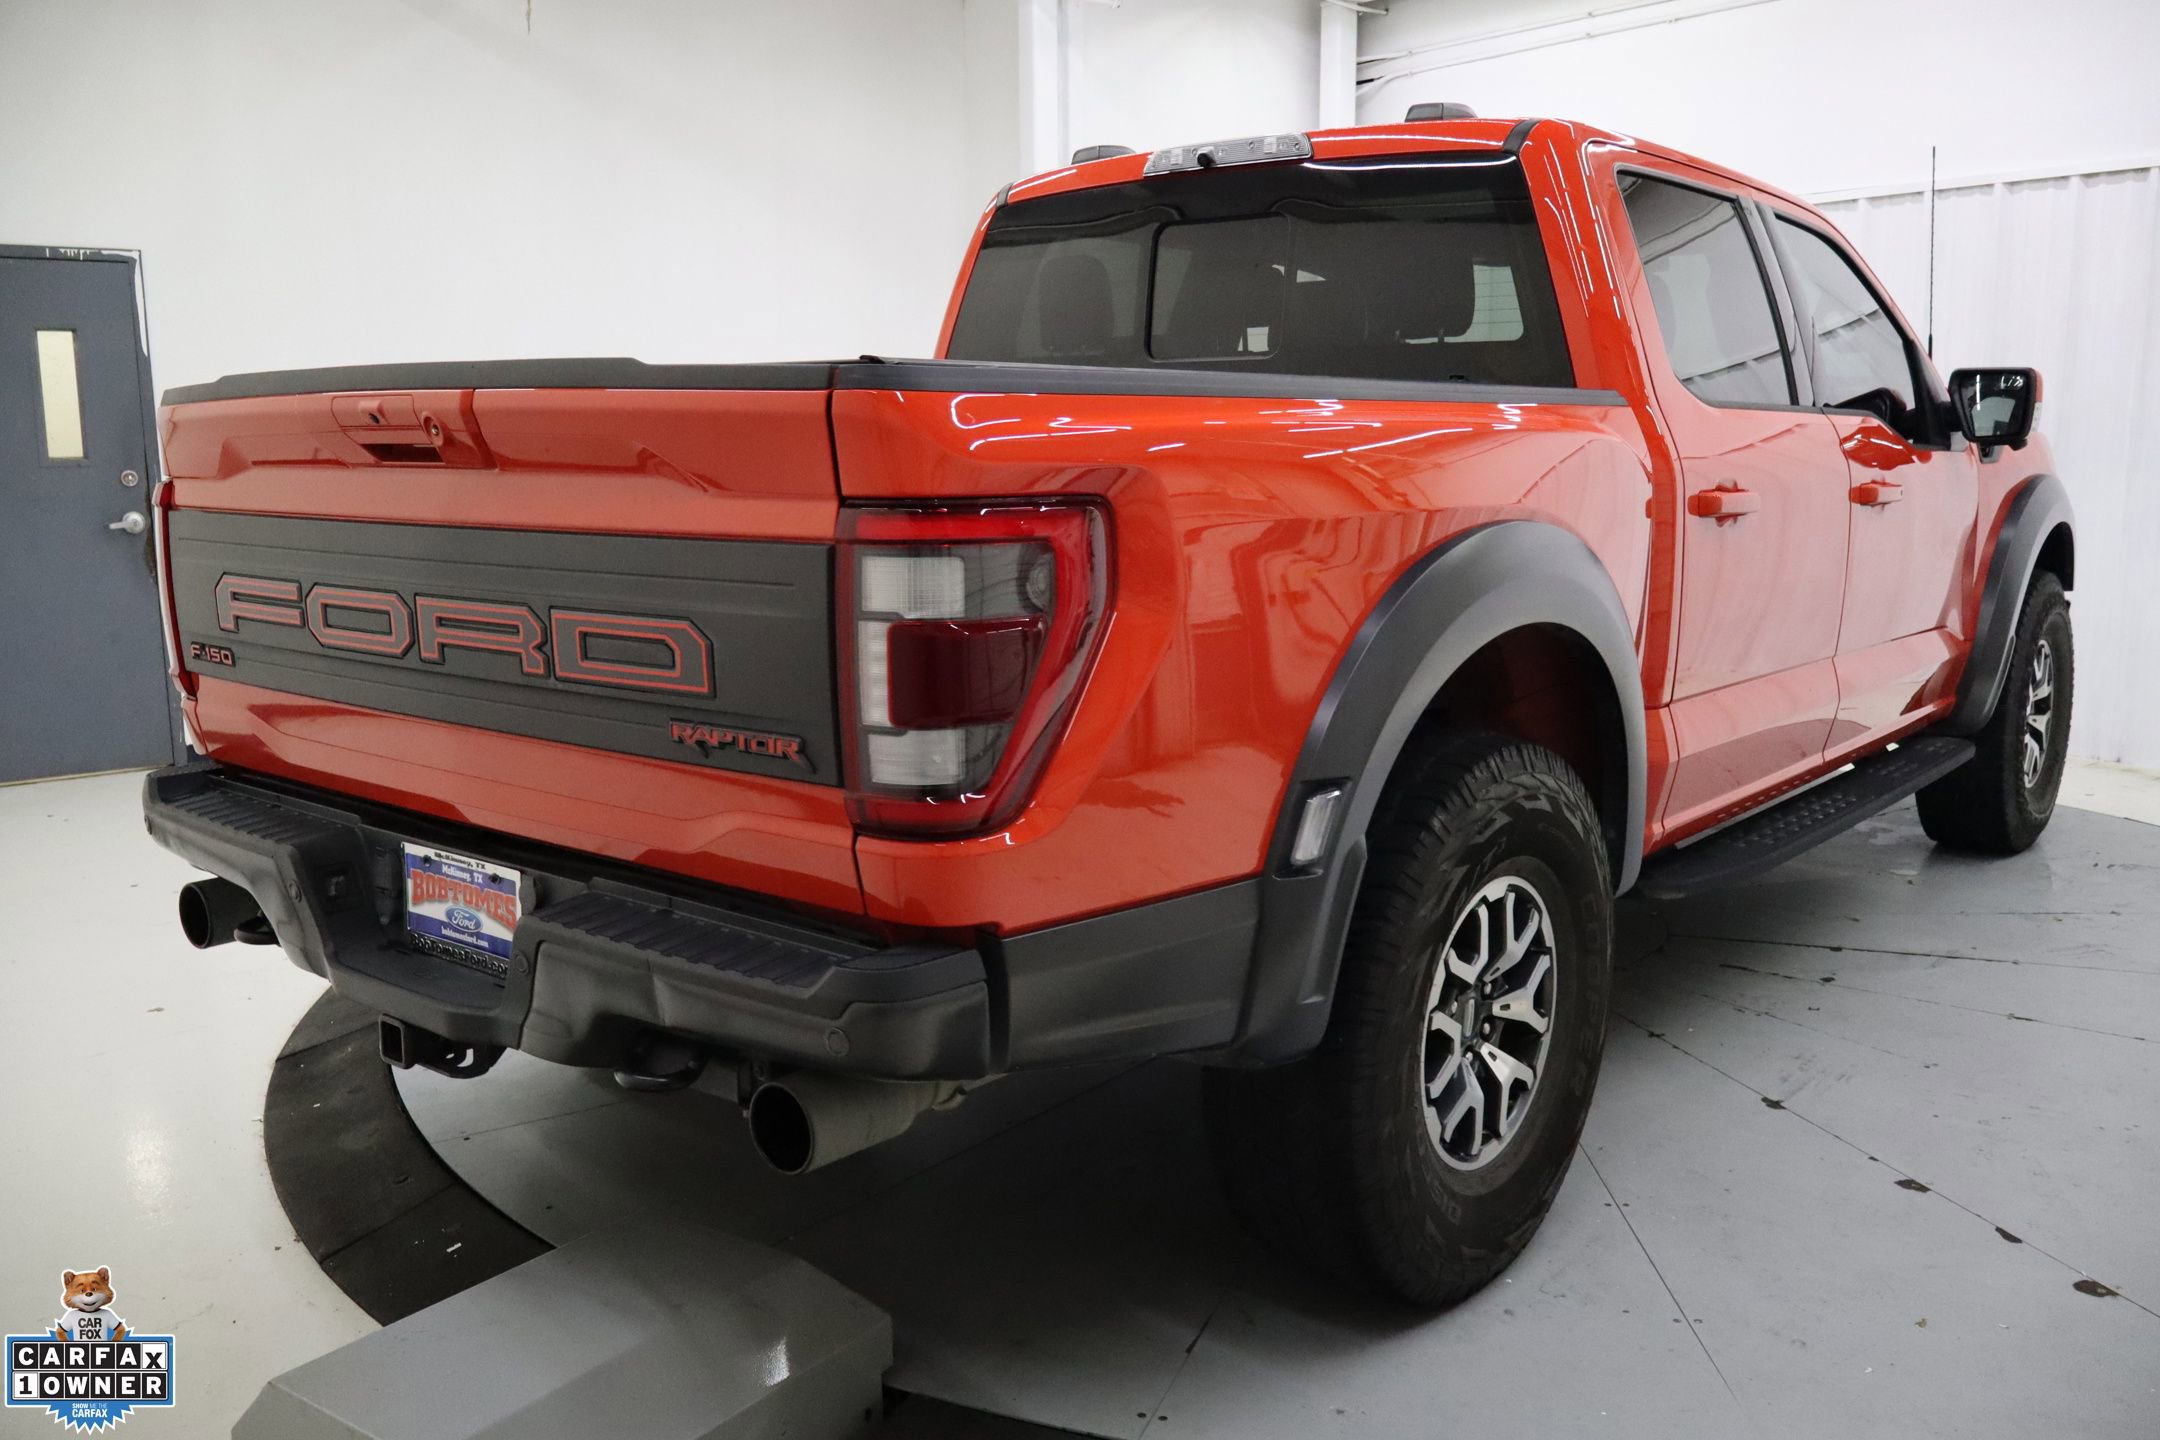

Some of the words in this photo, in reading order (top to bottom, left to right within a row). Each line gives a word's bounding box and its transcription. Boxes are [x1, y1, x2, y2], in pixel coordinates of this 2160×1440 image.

[215, 571, 716, 699] FORD
[190, 643, 234, 666] F-150
[669, 719, 805, 764] RAPTOR
[473, 872, 484, 884] TX
[451, 909, 476, 929] Ford
